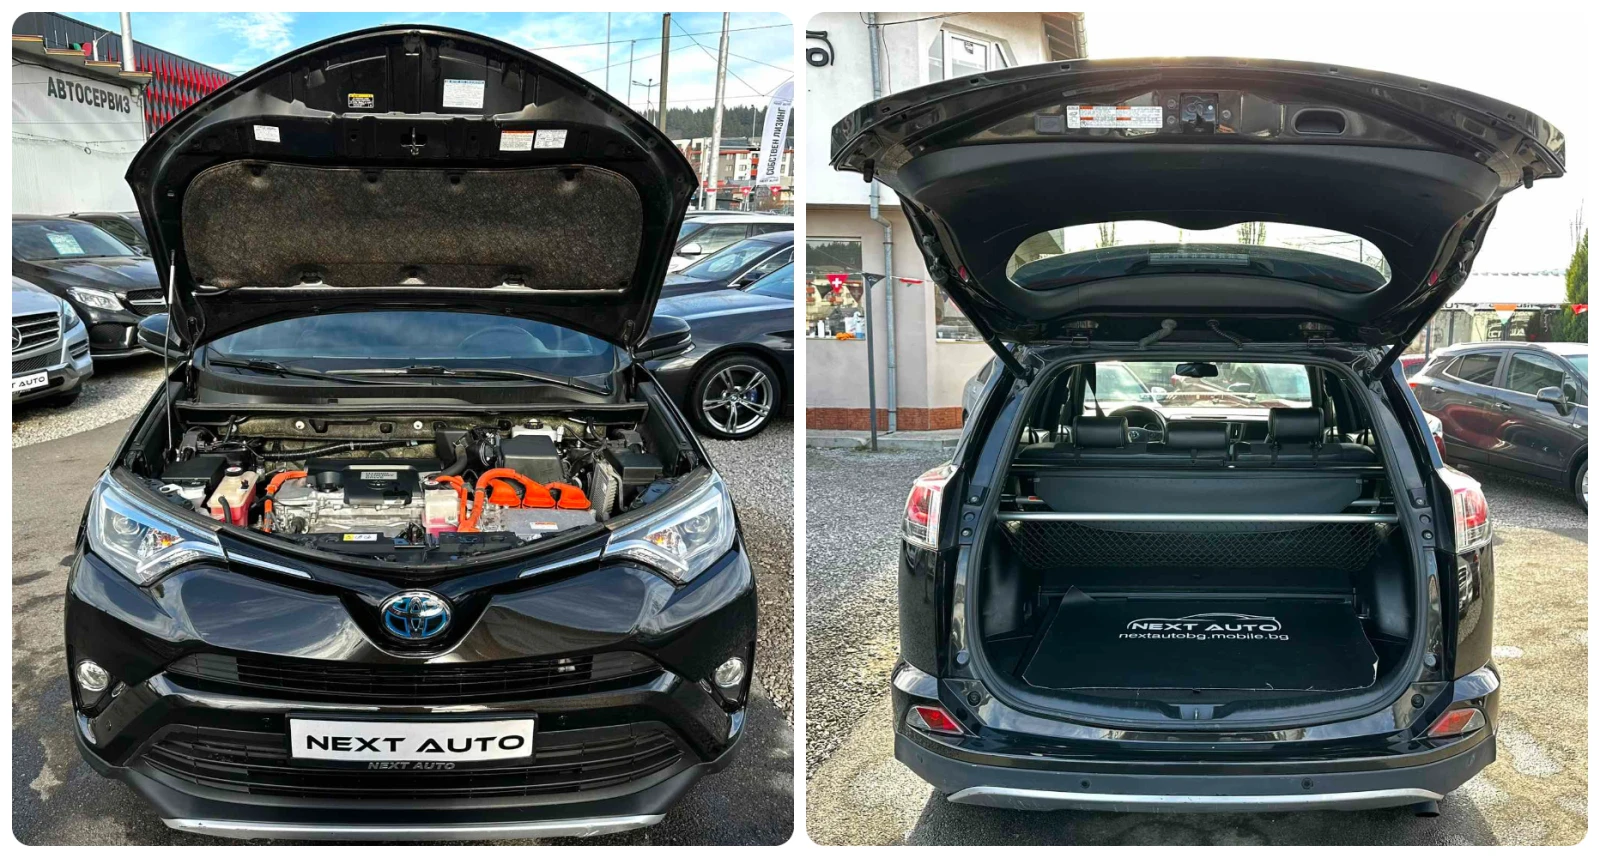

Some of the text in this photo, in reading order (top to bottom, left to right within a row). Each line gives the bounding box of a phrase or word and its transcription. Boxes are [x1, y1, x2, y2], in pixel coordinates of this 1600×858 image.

[48, 77, 131, 114] АВТОСЕРВИЗ
[766, 139, 779, 176] СОБСТВЕН
[773, 107, 786, 138] ЛИЗИНГ
[19, 376, 46, 388] AUTO
[1131, 623, 1278, 632] NEXT AUTO
[1118, 632, 1289, 641] nextautobg.mobile.bg
[306, 735, 525, 753] NEXT AUTO
[367, 761, 455, 770] NEXT AUTO
